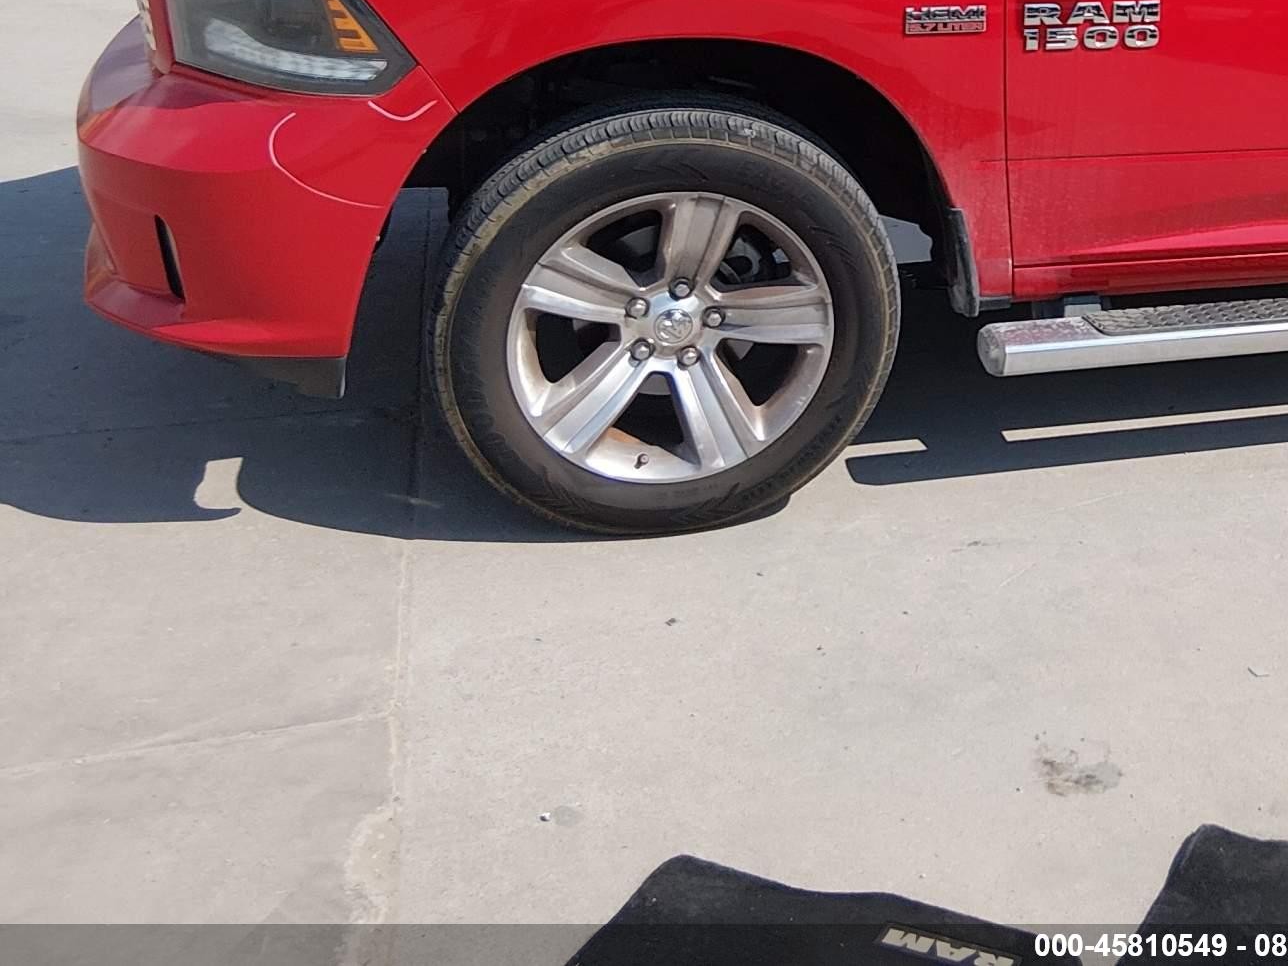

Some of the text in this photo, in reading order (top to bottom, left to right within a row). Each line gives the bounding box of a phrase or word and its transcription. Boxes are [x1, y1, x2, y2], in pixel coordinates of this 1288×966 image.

[905, 5, 987, 21] HEMI
[1024, 0, 1161, 26] RAM
[1024, 24, 1160, 51] 1500
[881, 927, 1015, 966] RAM
